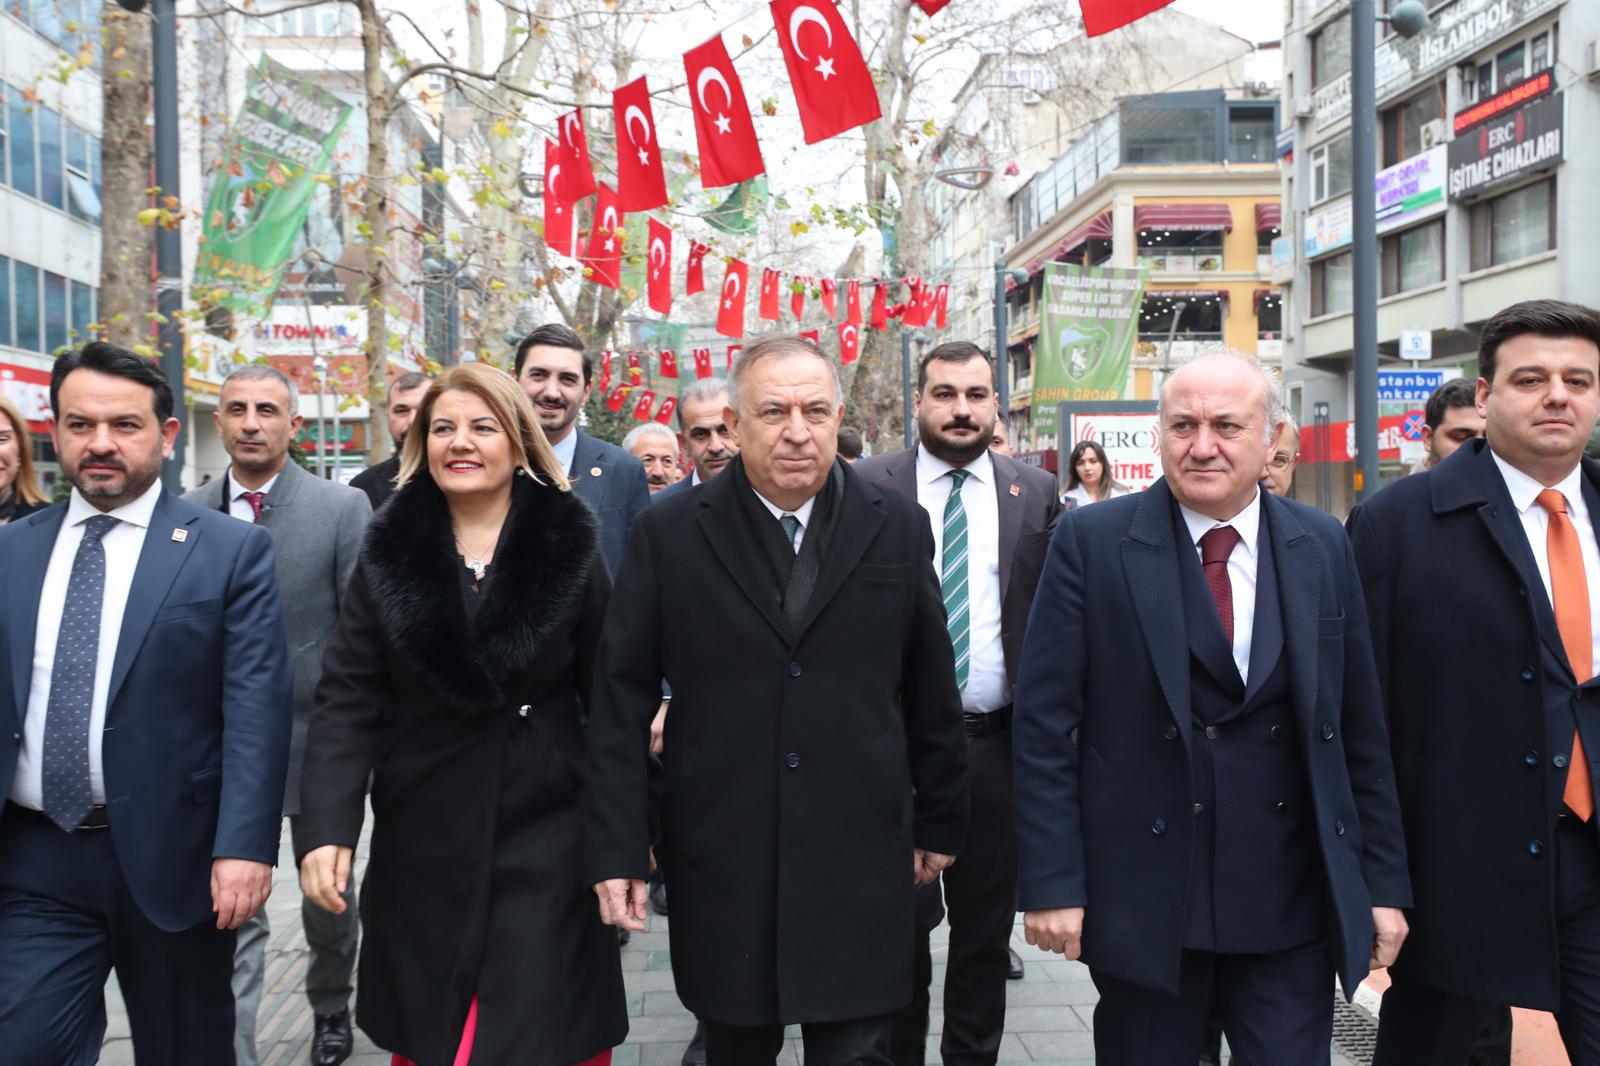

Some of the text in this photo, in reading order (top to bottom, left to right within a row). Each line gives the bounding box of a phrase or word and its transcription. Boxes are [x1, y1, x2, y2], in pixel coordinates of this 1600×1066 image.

[1488, 121, 1515, 150] ERC
[1449, 128, 1560, 198] İŞİTME CİHAZLARI
[1378, 374, 1442, 386] stanbul
[1073, 387, 1118, 401] GROUP
[1038, 406, 1057, 414] Pro
[1101, 431, 1148, 448] ERC
[1112, 459, 1154, 480] İTME
